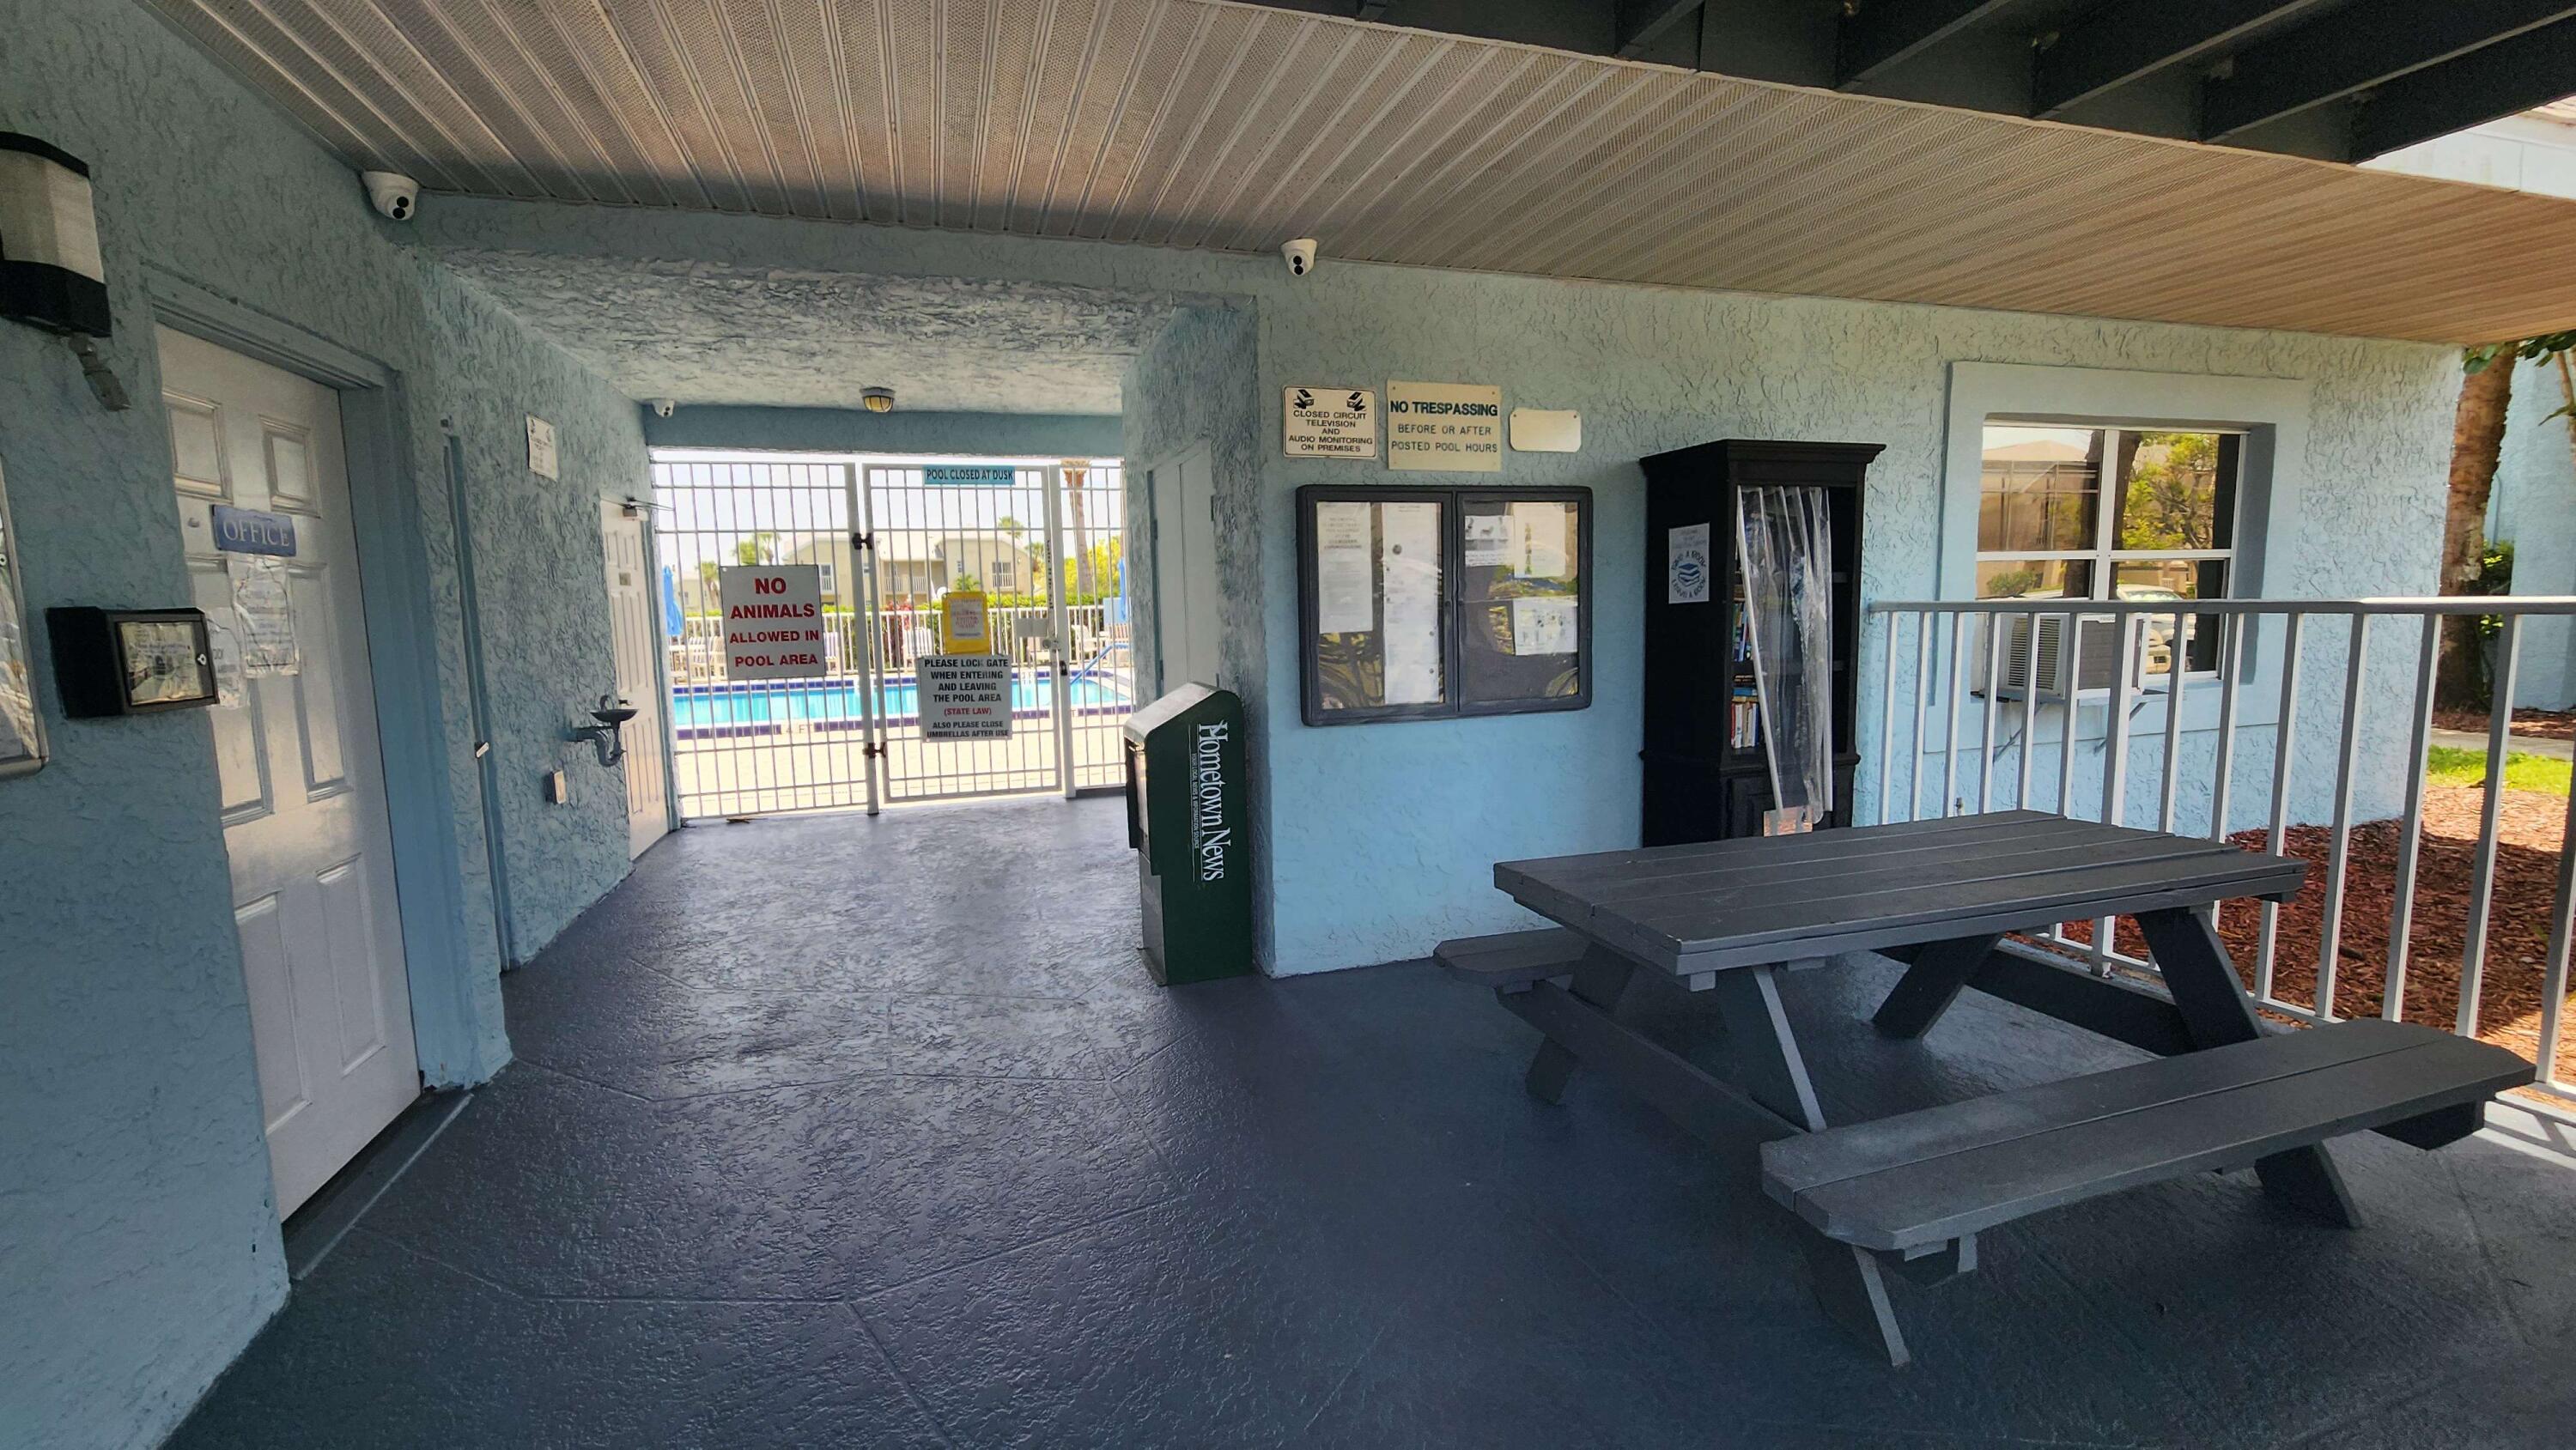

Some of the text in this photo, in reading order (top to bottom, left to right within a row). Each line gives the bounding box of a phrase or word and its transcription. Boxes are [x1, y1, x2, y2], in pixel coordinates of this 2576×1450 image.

[1390, 400, 1498, 416] NO TRESPASSING
[1333, 411, 1367, 420] CIRCUIT
[1305, 419, 1356, 428] TELEVISION
[1398, 424, 1492, 435] BEFORE OR AFTER
[1319, 436, 1373, 445] MONITORING
[1391, 440, 1498, 453] POSTED POOL HOURS
[927, 470, 1013, 480] POOL CLOSED AT DUSK
[223, 520, 290, 547] OFFICE
[755, 577, 787, 595] NO
[730, 603, 816, 620] ANIMALS
[730, 629, 819, 644] ALLOWED IN
[735, 653, 818, 668] POOL AREA
[924, 658, 958, 668] PLEASE
[986, 658, 1008, 668] GATE
[931, 670, 1003, 680] WHEN ENTERING
[939, 682, 997, 691] AND LEAVING
[933, 694, 1002, 702] THE POOL AREA
[944, 707, 992, 717] (STATE LAW)
[1199, 719, 1231, 881] Hometown News
